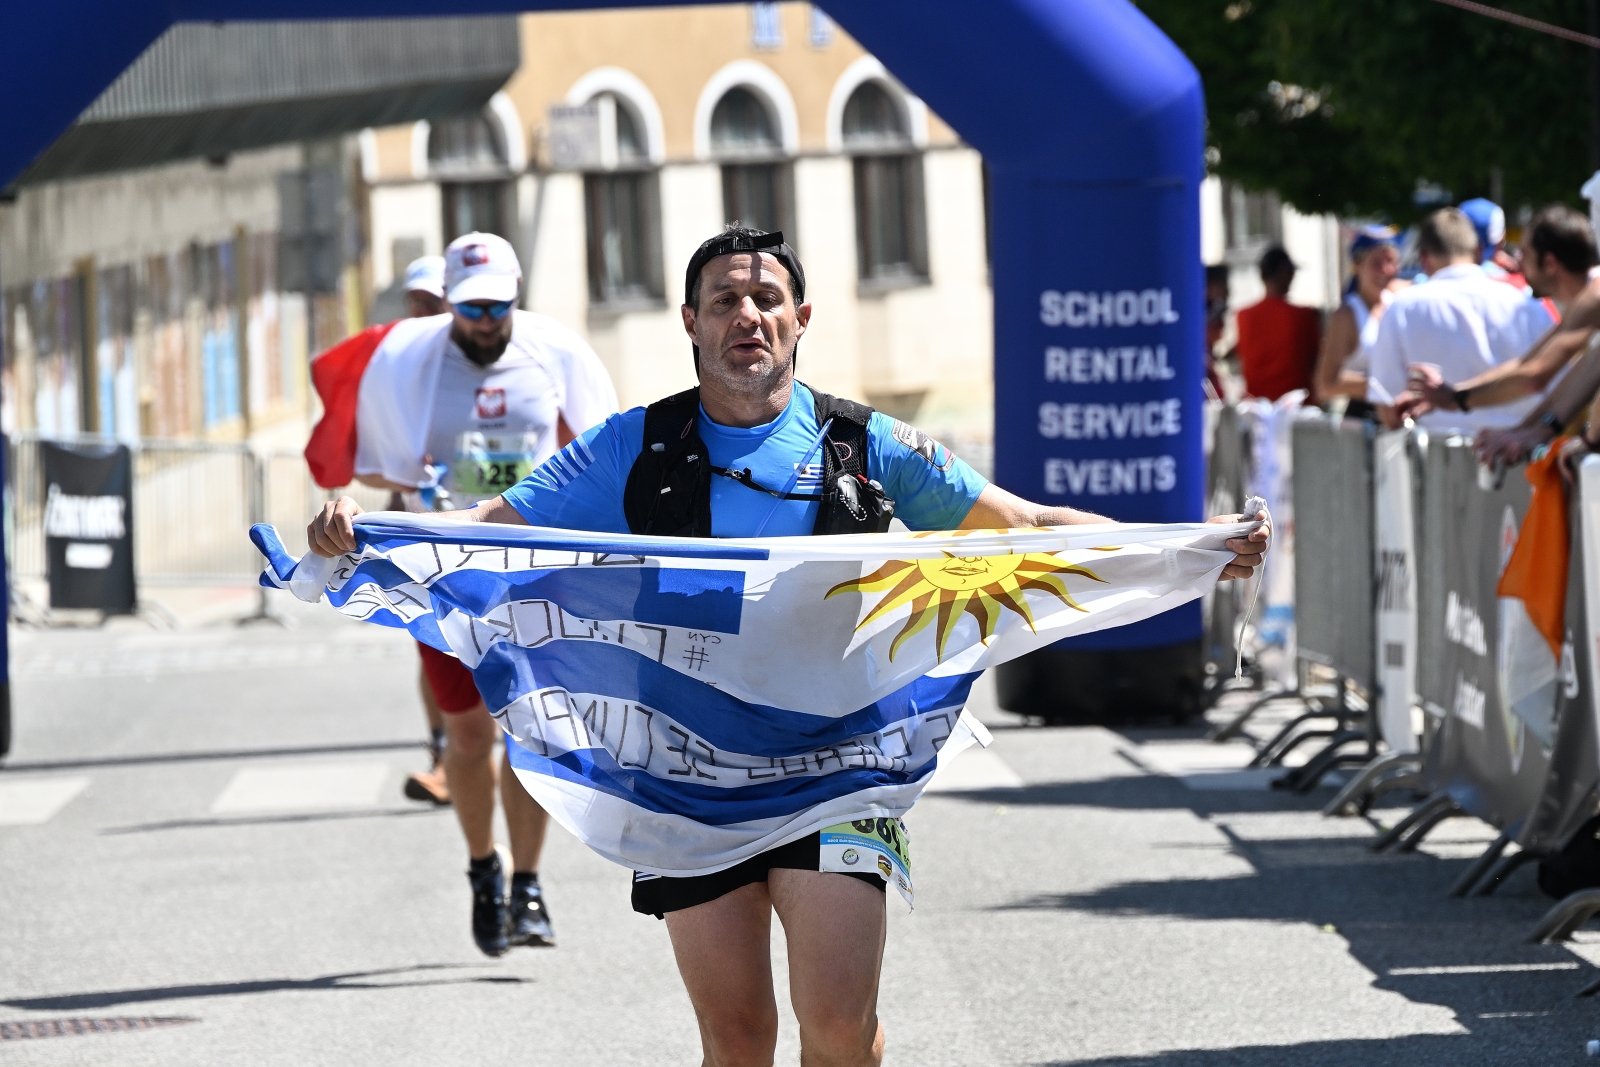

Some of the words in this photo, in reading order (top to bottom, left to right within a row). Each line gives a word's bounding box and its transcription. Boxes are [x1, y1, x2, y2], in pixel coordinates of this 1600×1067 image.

[1040, 287, 1179, 327] SCHOOL
[1045, 344, 1175, 384] RENTAL
[1038, 398, 1181, 440] SERVICE
[1044, 455, 1176, 495] EVENTS
